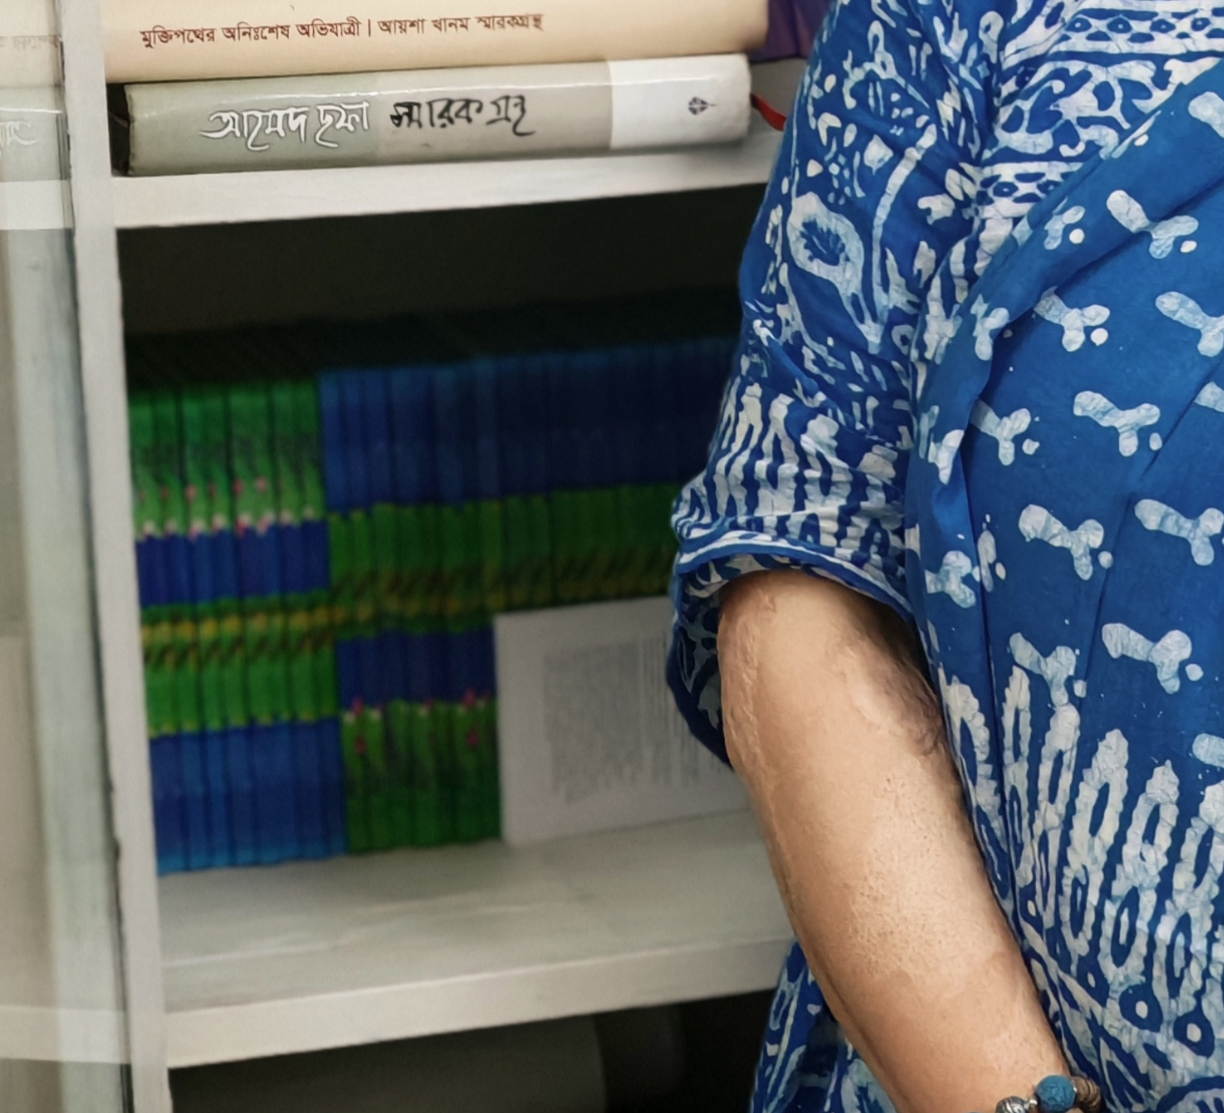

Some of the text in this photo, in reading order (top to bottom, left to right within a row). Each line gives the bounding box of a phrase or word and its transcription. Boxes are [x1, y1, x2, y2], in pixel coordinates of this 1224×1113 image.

[140, 24, 216, 48] মুক্তিপথের
[221, 21, 291, 42] অনিঃশেষ
[295, 16, 362, 38] অভিযাত্রী
[377, 18, 426, 35] আয়শা
[432, 16, 471, 33] খানম
